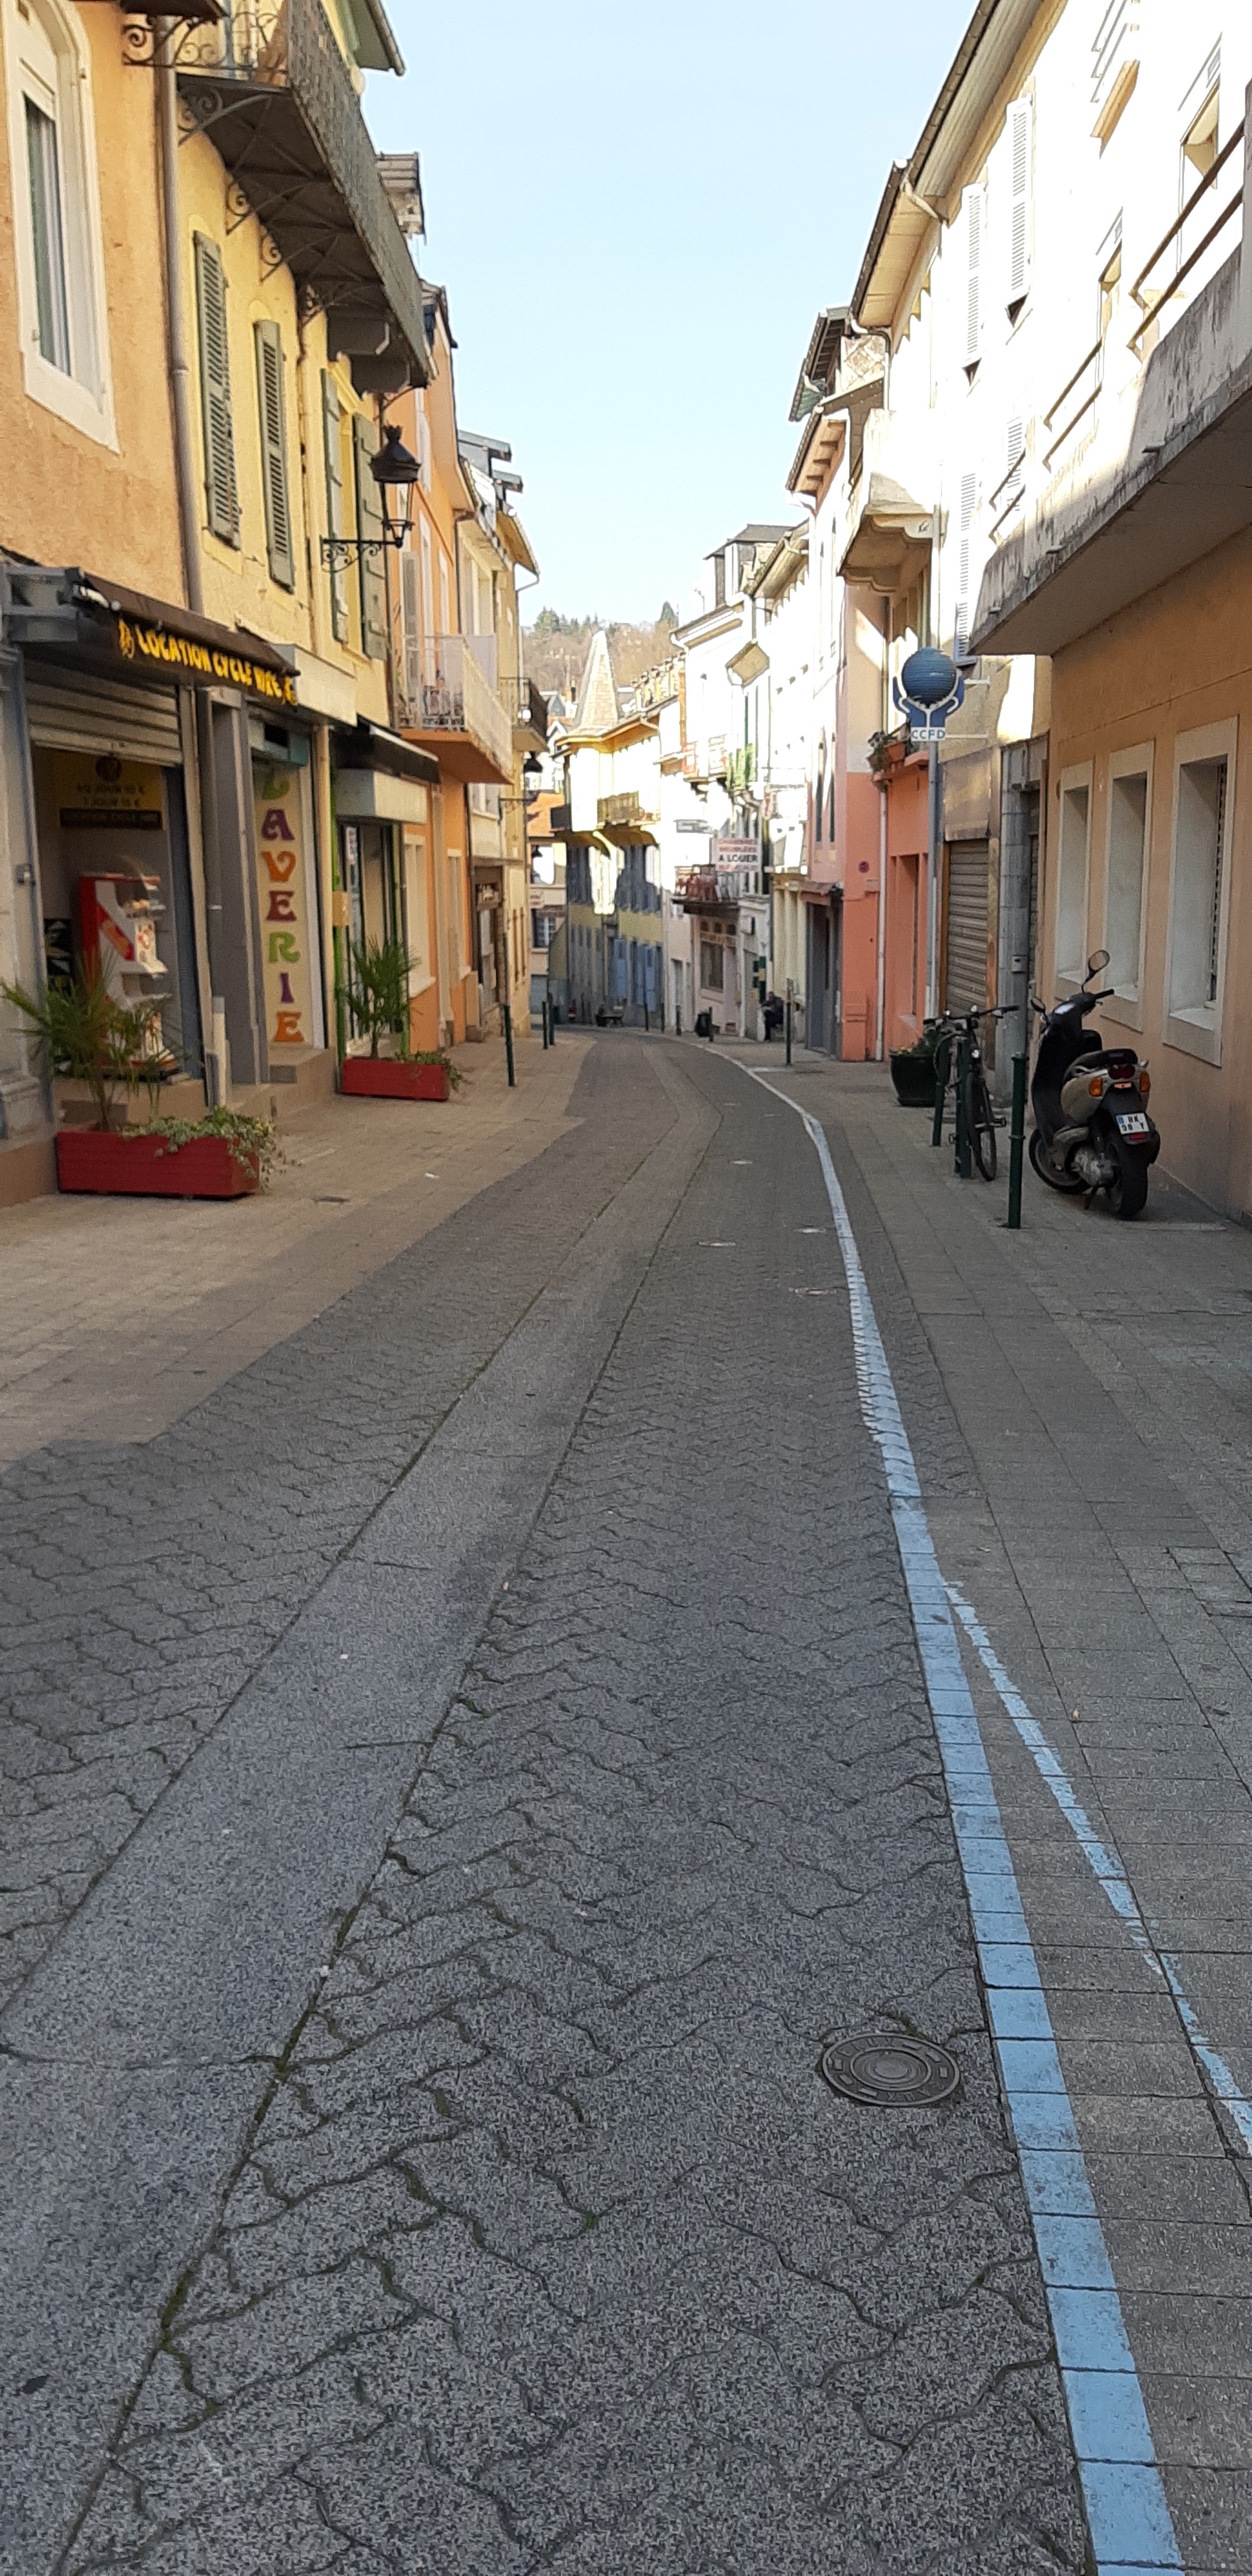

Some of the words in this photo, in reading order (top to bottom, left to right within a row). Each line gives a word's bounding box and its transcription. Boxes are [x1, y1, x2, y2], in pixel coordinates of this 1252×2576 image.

[136, 625, 212, 673] LOCATION
[212, 651, 252, 685] CYCLE
[912, 729, 945, 740] CCFD
[727, 854, 758, 862] LOUER
[261, 770, 304, 1042] LAVERIE
